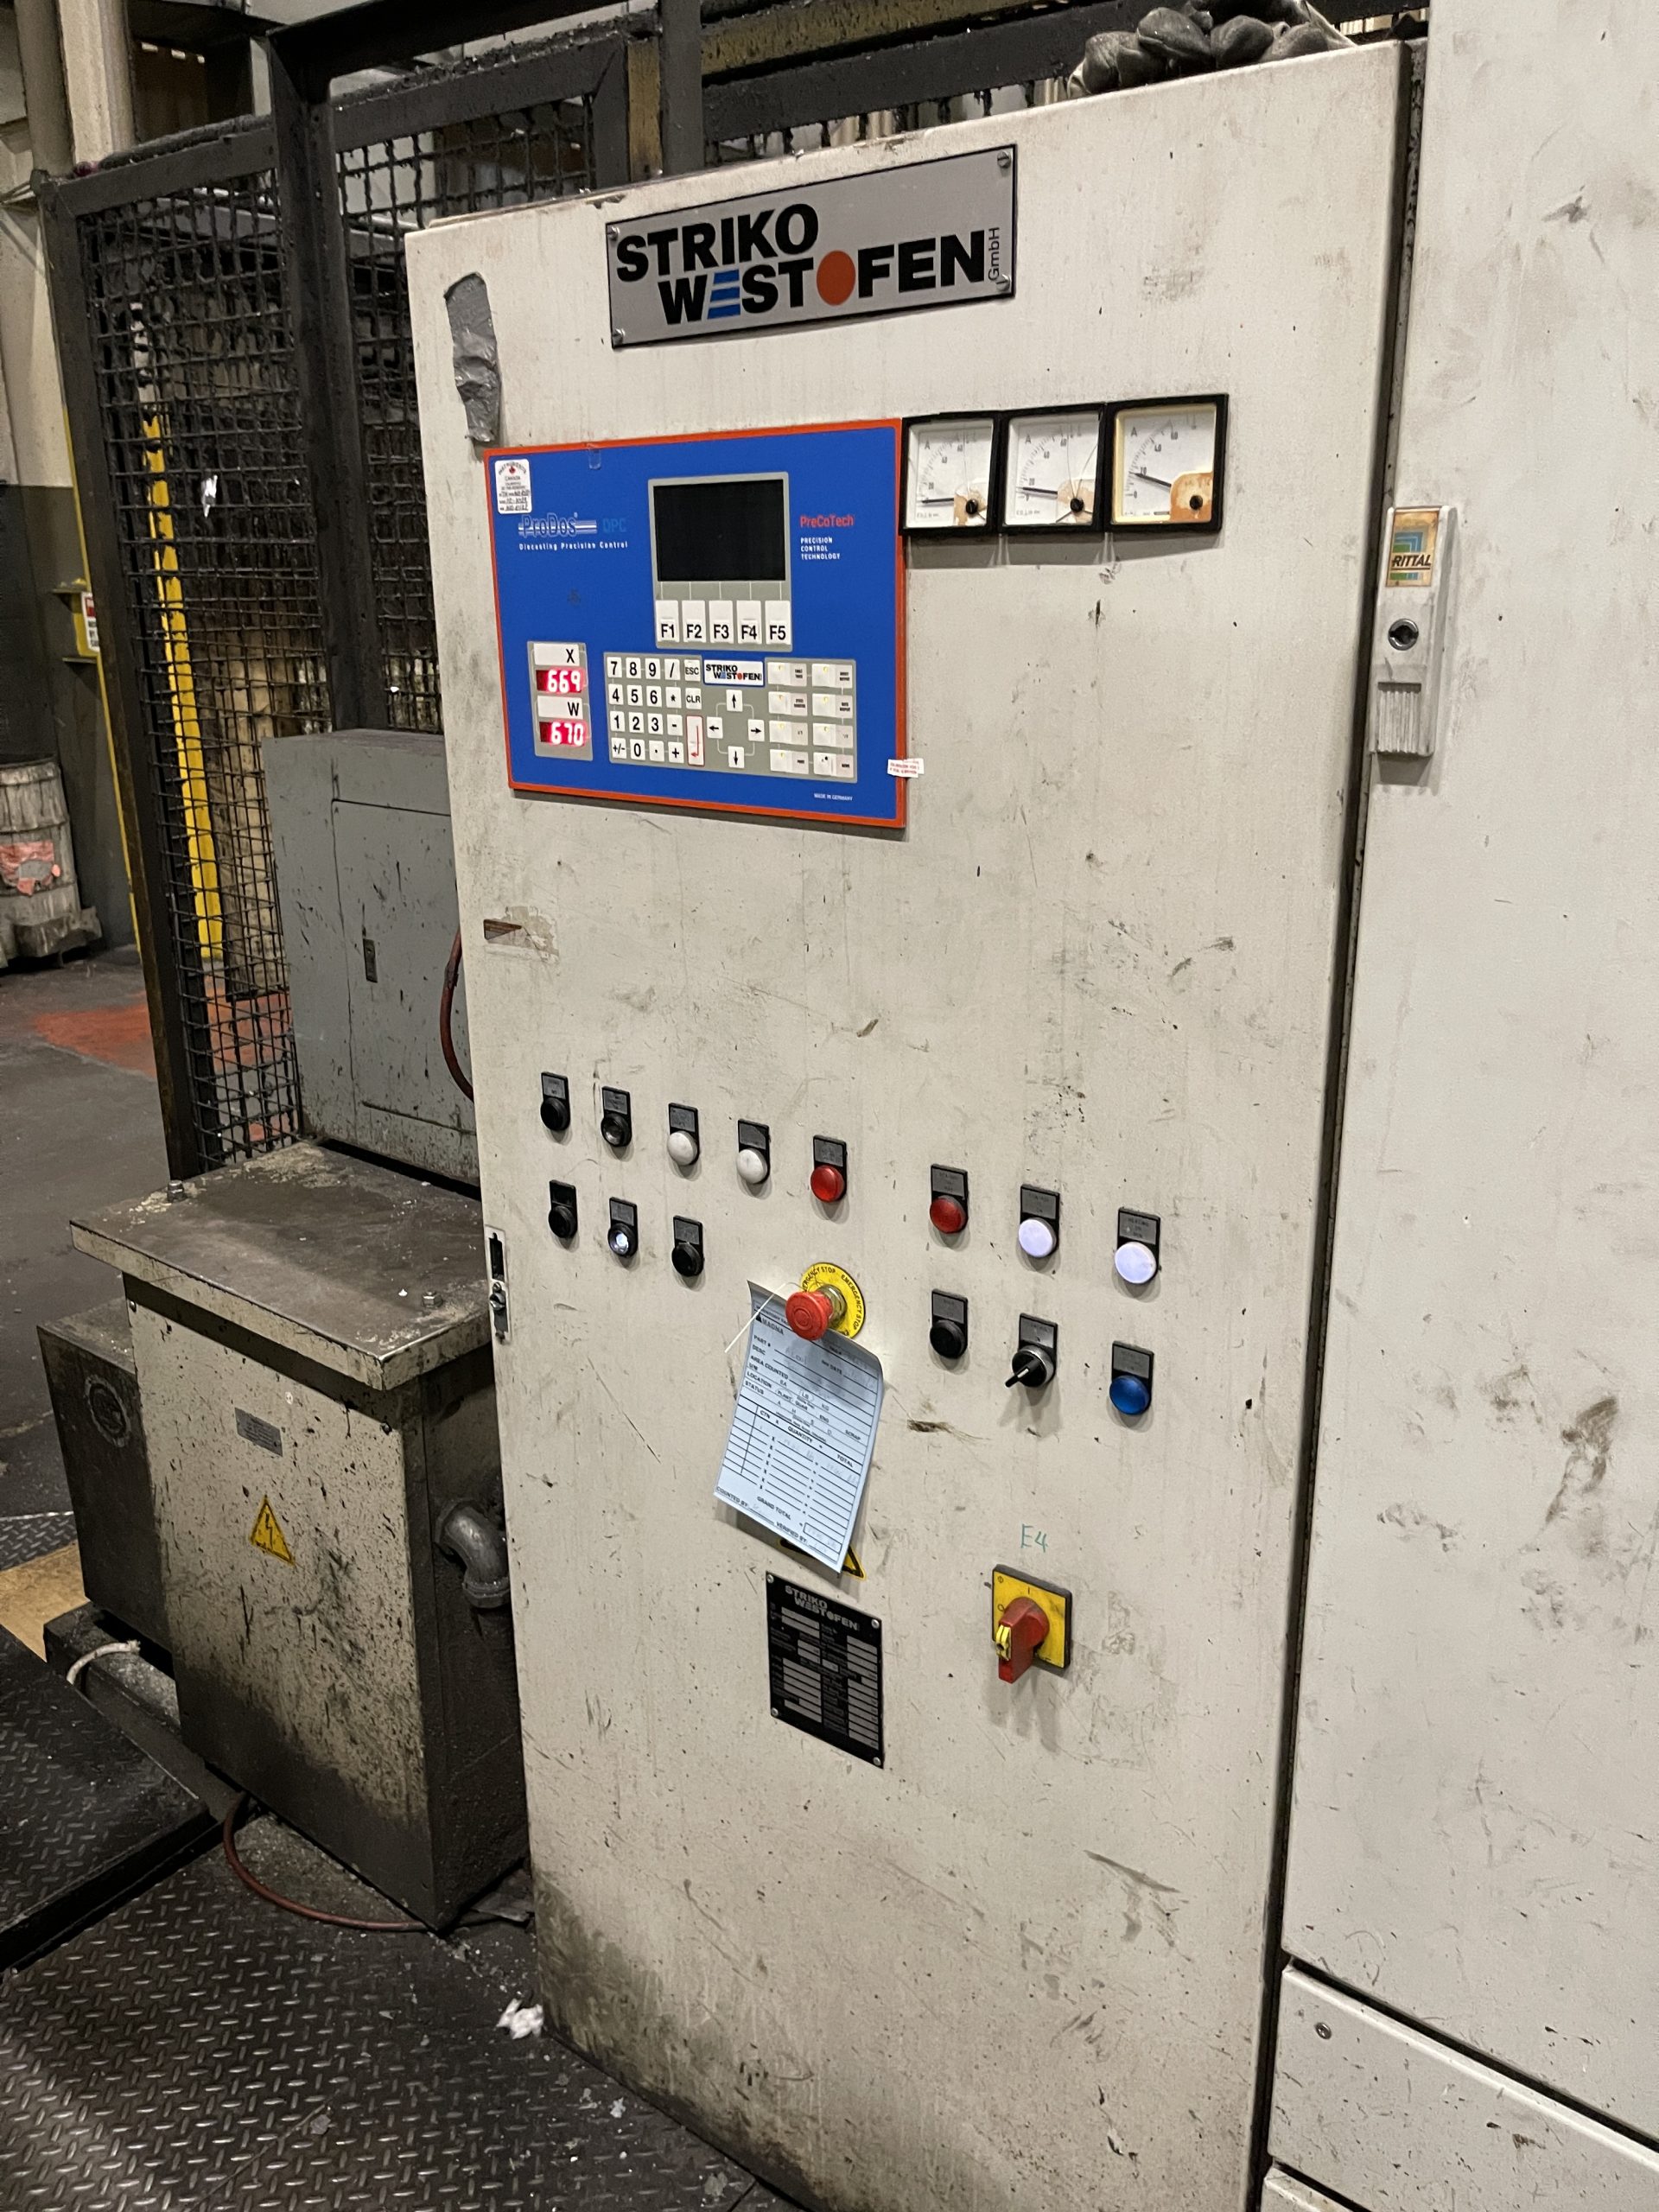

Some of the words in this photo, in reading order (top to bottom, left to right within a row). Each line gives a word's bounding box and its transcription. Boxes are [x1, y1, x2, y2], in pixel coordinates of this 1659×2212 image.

[616, 203, 819, 283] STRIKO
[988, 226, 1001, 283] GmbH
[658, 229, 986, 325] WESTOFEN
[800, 515, 854, 528] PreCoTech
[518, 543, 557, 551] Diecasting
[1392, 554, 1432, 567] RITTAL
[661, 624, 675, 639] F1
[686, 624, 702, 639] F2
[714, 624, 729, 639] F3
[741, 625, 757, 639] F4
[769, 625, 786, 640] F5
[566, 649, 575, 664] X
[610, 661, 618, 676] 7
[629, 661, 638, 677] 8
[648, 662, 657, 677] 9
[685, 666, 699, 676] ESC
[706, 664, 738, 672] STRIKO
[548, 669, 582, 692] 669
[612, 688, 620, 702] 4
[631, 689, 639, 703] 5
[650, 690, 658, 704] 6
[686, 695, 701, 703] CLR
[568, 702, 579, 716] W
[632, 716, 640, 731] 2
[651, 717, 659, 732] 3
[551, 721, 584, 747] 670
[633, 742, 641, 758] 0
[841, 1274, 862, 1313] EMERGENCY
[853, 1314, 862, 1330] STOP
[762, 1318, 785, 1335] MAGNA
[753, 1334, 767, 1344] PART
[753, 1344, 766, 1356] DESC
[751, 1355, 765, 1366] AREA
[764, 1363, 789, 1380] COUNTED
[830, 1364, 842, 1375] DATE
[747, 1370, 772, 1389] LOCATION
[745, 1380, 765, 1395] STATUS
[760, 1410, 771, 1419] CTN
[788, 1426, 812, 1443] QUANTITY
[836, 1453, 853, 1468] TOTAL
[716, 1485, 741, 1503] COUNTED
[757, 1496, 775, 1510] GRAND
[776, 1506, 791, 1521] TOTAL
[777, 1521, 799, 1538] VERIFIED
[785, 1585, 828, 1609] STRIKO
[794, 1596, 859, 1631] WESTOFEN
